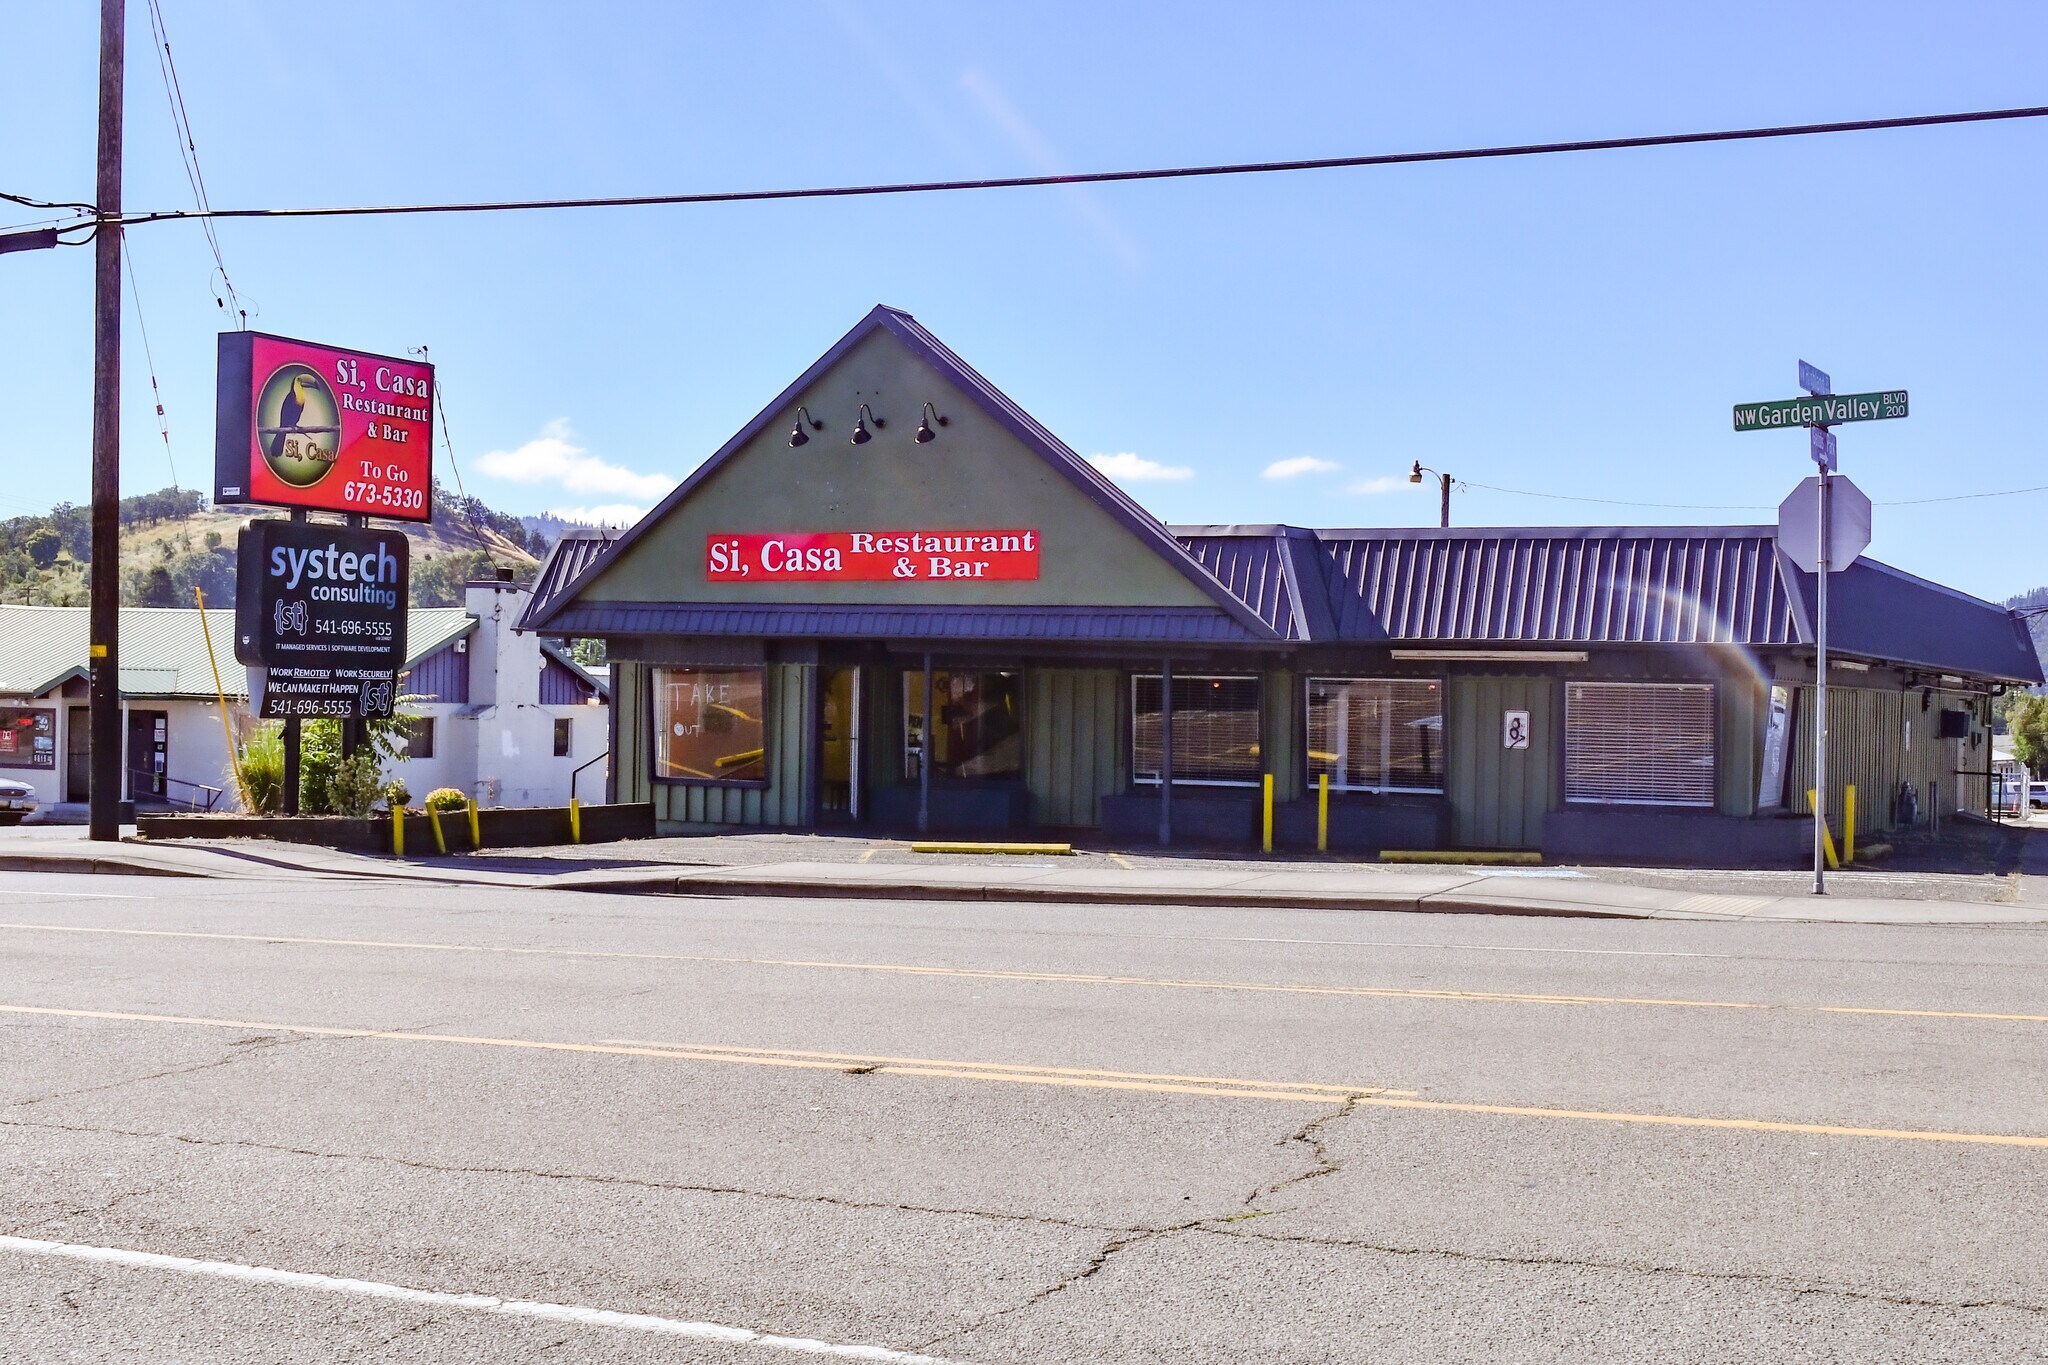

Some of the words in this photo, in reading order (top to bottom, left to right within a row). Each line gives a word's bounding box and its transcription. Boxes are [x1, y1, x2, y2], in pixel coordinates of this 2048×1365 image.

[336, 359, 366, 392] Si,
[375, 367, 429, 399] Casa
[342, 393, 428, 423] Restaurant
[1735, 408, 1757, 426] NW
[1758, 404, 1823, 426] Garden
[1824, 398, 1880, 421] Valley
[1883, 392, 1907, 406] BLVD
[1886, 405, 1906, 418] 200
[367, 422, 378, 439] &
[383, 424, 408, 443] Bar
[285, 438, 303, 462] Si,
[305, 442, 336, 463] Casa
[360, 460, 382, 479] To
[386, 464, 408, 483] Go
[344, 481, 423, 509] 673-5330
[270, 542, 398, 590] systech
[709, 539, 750, 577] Si,
[760, 540, 843, 573] Casa
[849, 531, 1036, 554] Restaurant
[892, 557, 918, 578] &
[927, 557, 990, 578] Bar
[311, 583, 397, 610] consulting
[315, 619, 392, 636] 541-696-5555
[281, 643, 306, 651] MANAGED
[306, 644, 327, 652] SERVICES
[331, 644, 357, 652] SOFTWARE
[269, 699, 352, 715] 541-696-5555
[668, 682, 730, 711] TAKE
